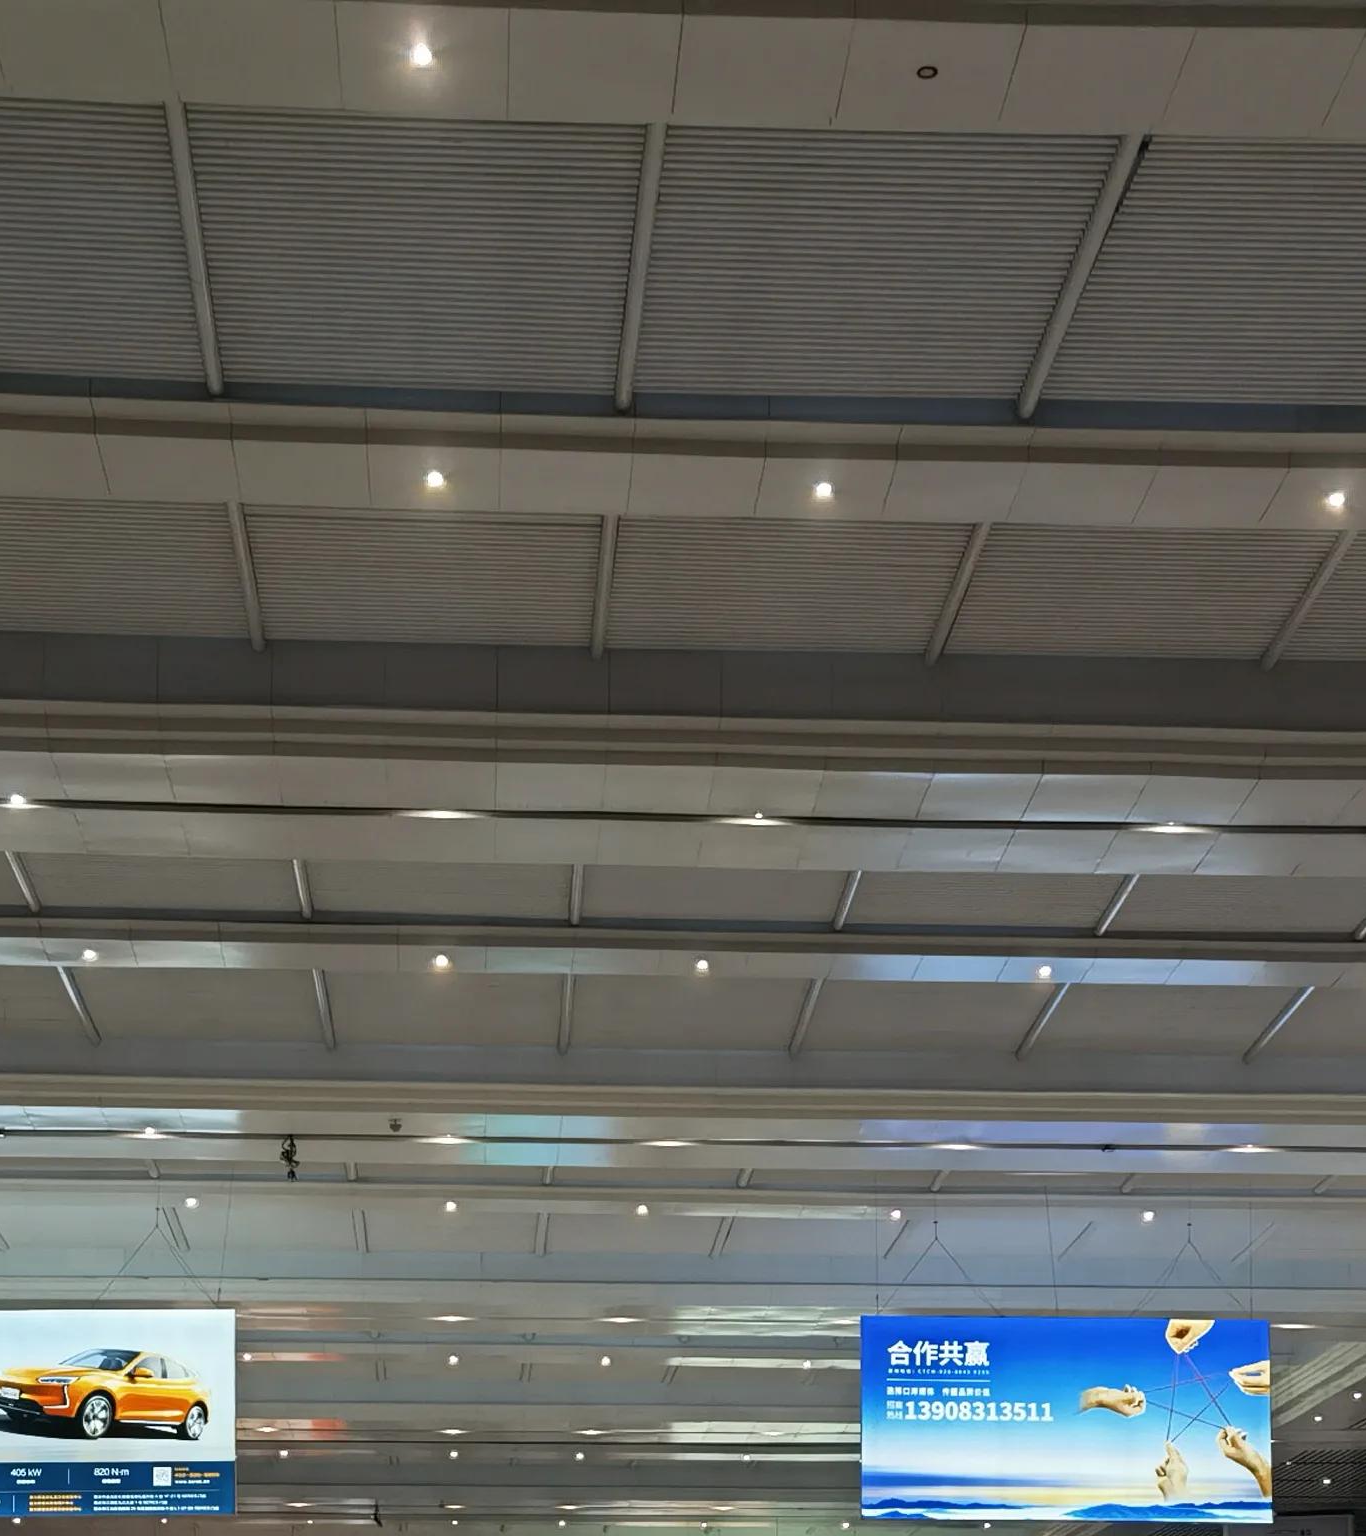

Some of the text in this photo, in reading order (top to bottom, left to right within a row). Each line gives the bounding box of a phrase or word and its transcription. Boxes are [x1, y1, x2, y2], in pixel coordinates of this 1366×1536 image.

[887, 1340, 990, 1367] 合作共赢
[905, 1401, 1054, 1421] 13908313511
